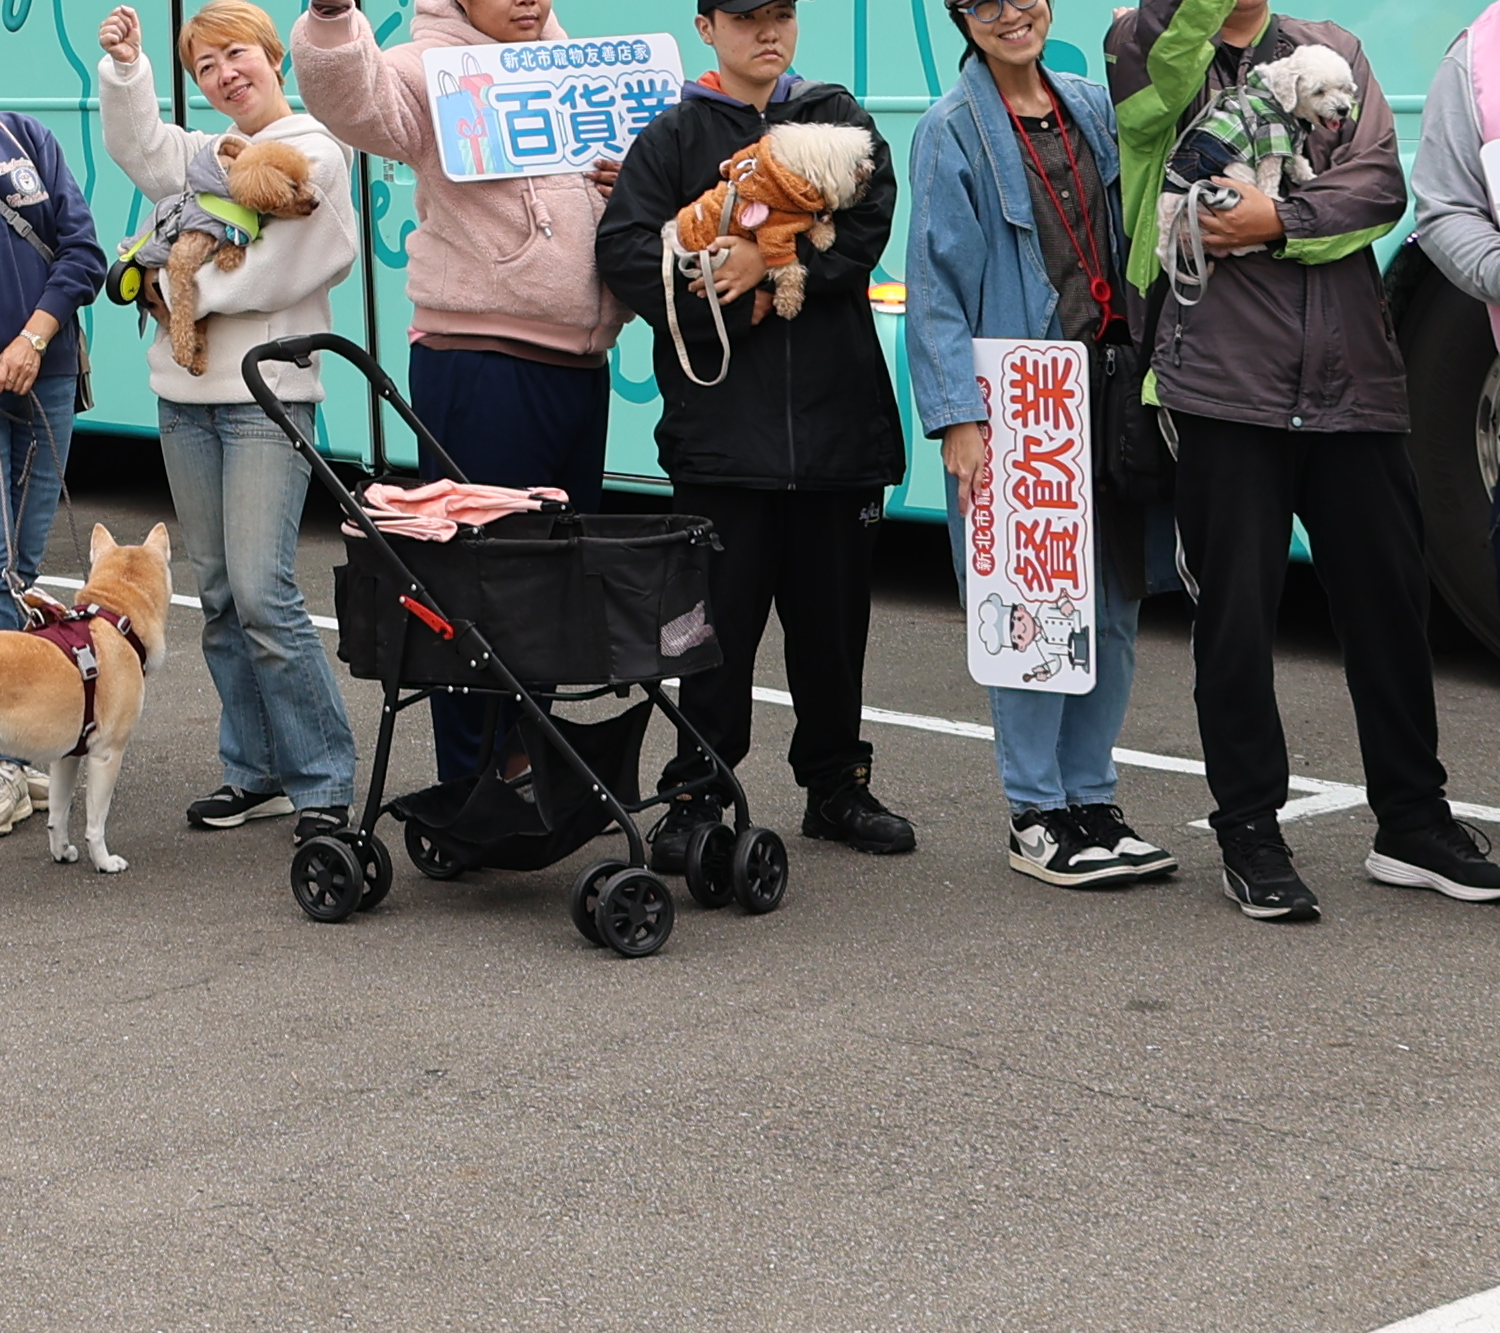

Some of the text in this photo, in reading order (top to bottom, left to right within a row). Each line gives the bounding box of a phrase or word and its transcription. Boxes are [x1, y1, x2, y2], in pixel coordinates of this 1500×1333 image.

[503, 43, 649, 69] 新北市寵物友善店家
[494, 77, 677, 158] 百貨業
[1009, 354, 1080, 593] 餐飲業
